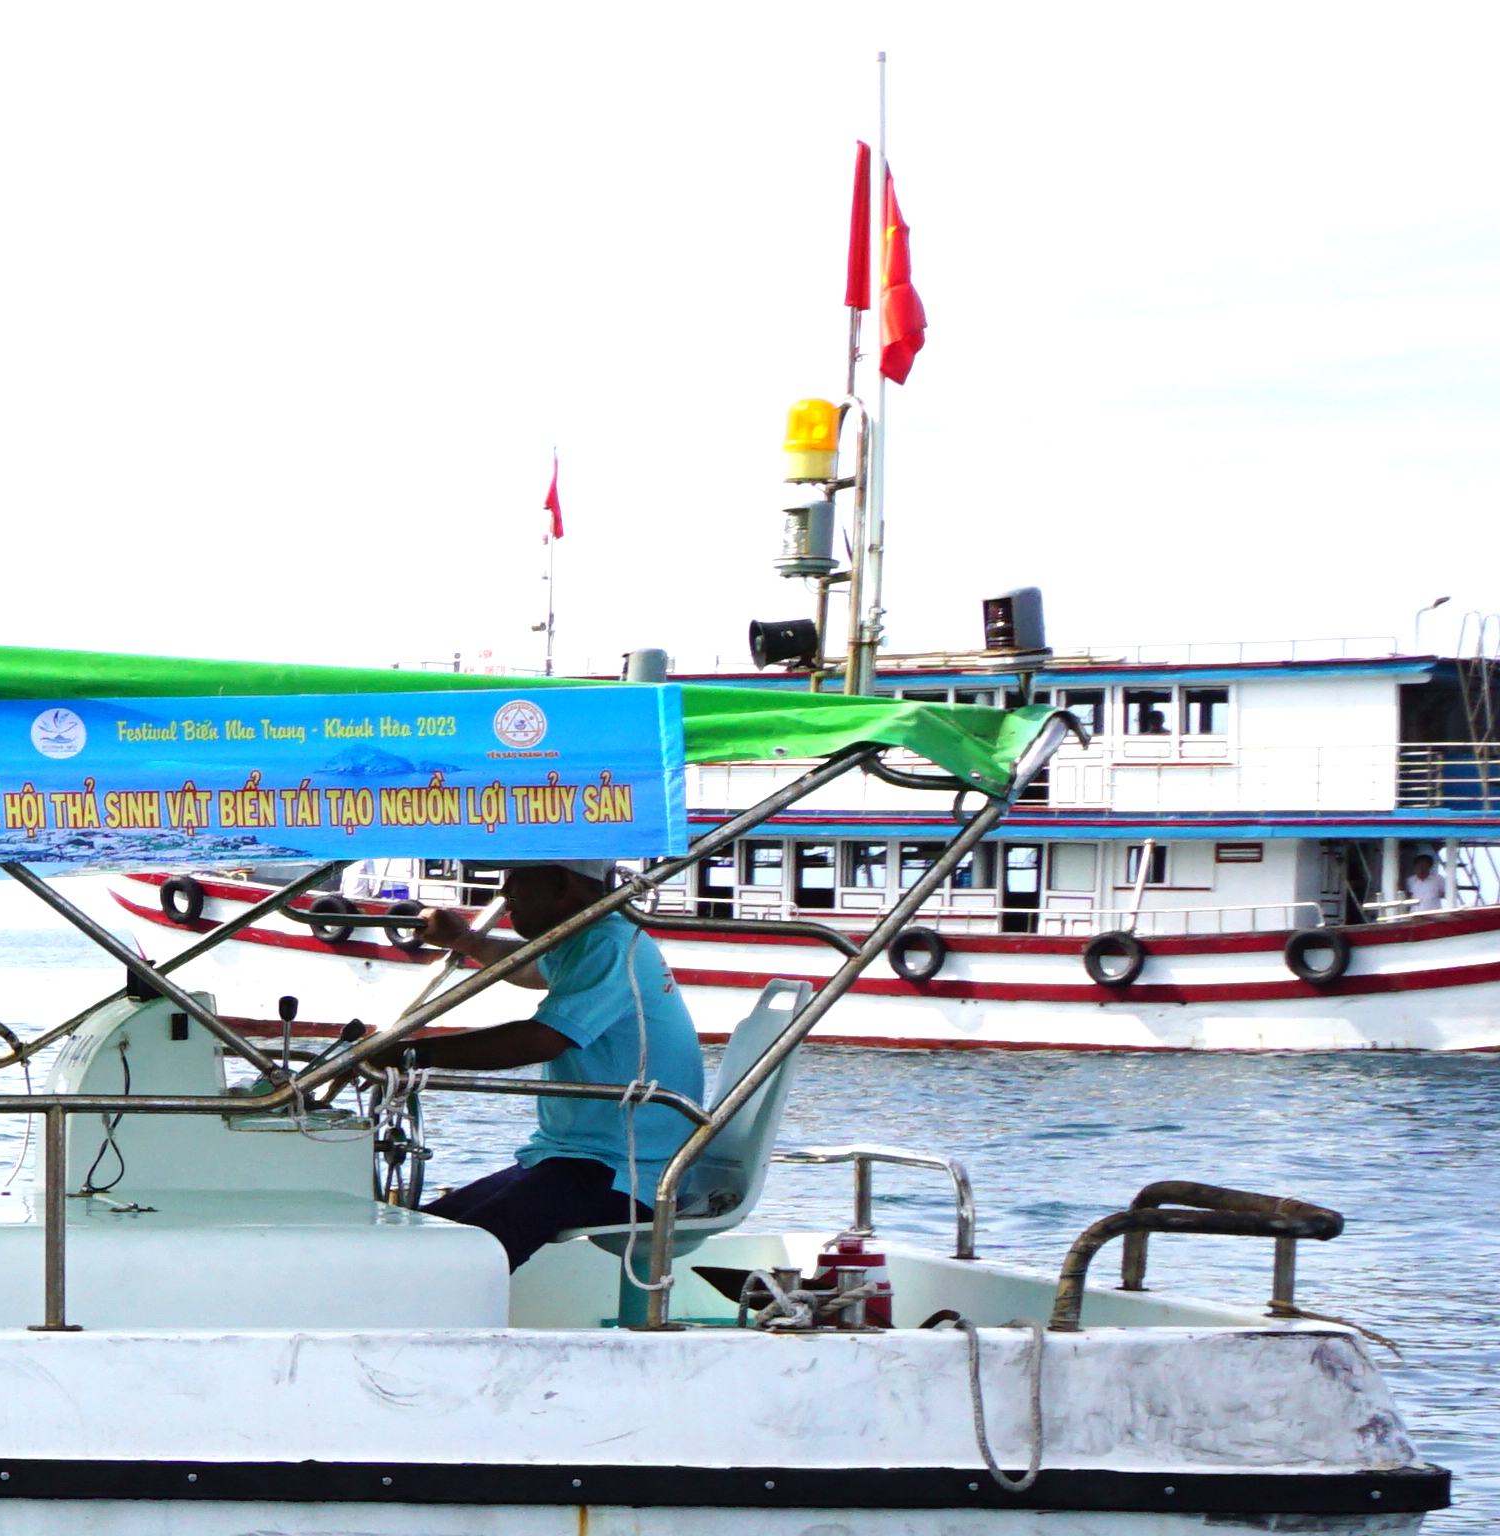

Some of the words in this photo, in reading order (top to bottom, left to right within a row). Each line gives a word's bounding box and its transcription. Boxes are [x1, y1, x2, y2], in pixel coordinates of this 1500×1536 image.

[116, 720, 178, 741] Festival
[181, 719, 220, 741] Biển
[225, 719, 256, 740] Nha
[261, 718, 305, 742] Trang
[323, 717, 375, 738] Khánh
[417, 716, 457, 737] 2023
[3, 783, 46, 838] HỘI
[50, 777, 100, 829] THẢ
[104, 790, 160, 828] SINH
[165, 780, 212, 836] VẬT
[218, 769, 275, 828] BIỂN
[281, 778, 320, 827] TÁI
[326, 788, 374, 835] TẠO
[380, 771, 461, 826] NGUỒN
[467, 781, 507, 834] LỢI
[511, 771, 577, 824] THỦY
[583, 770, 633, 823] SẢN
